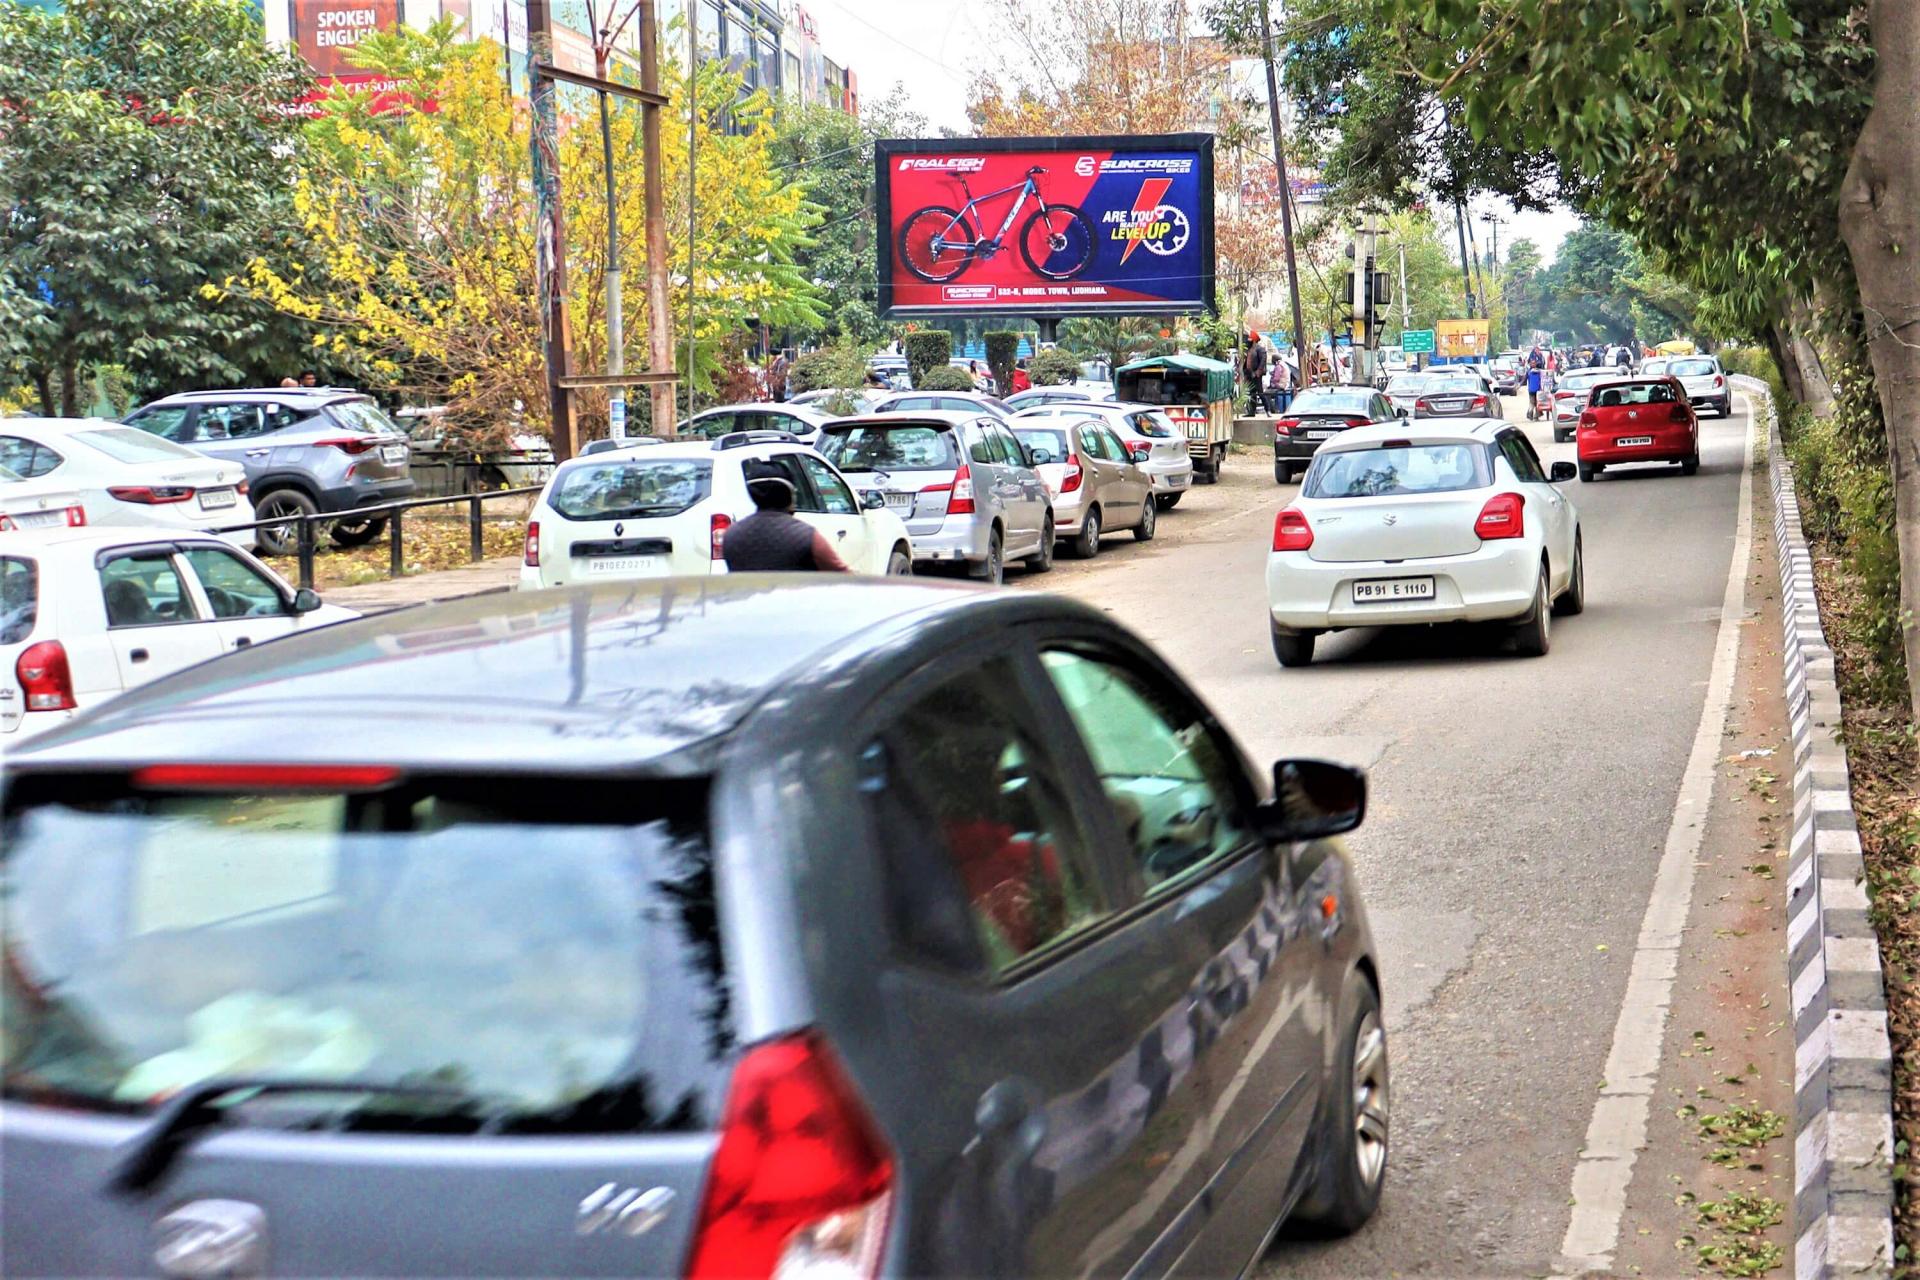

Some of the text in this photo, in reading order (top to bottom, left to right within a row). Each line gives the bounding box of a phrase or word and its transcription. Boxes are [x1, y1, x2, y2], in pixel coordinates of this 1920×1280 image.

[317, 10, 376, 27] SPOKEN
[914, 158, 986, 168] RALEIGH
[1100, 159, 1193, 168] SUNCROSS
[1102, 210, 1155, 223] ARE YOU
[1111, 222, 1171, 240] LEVEL UP
[1357, 583, 1427, 596] PB 91 E 1110
